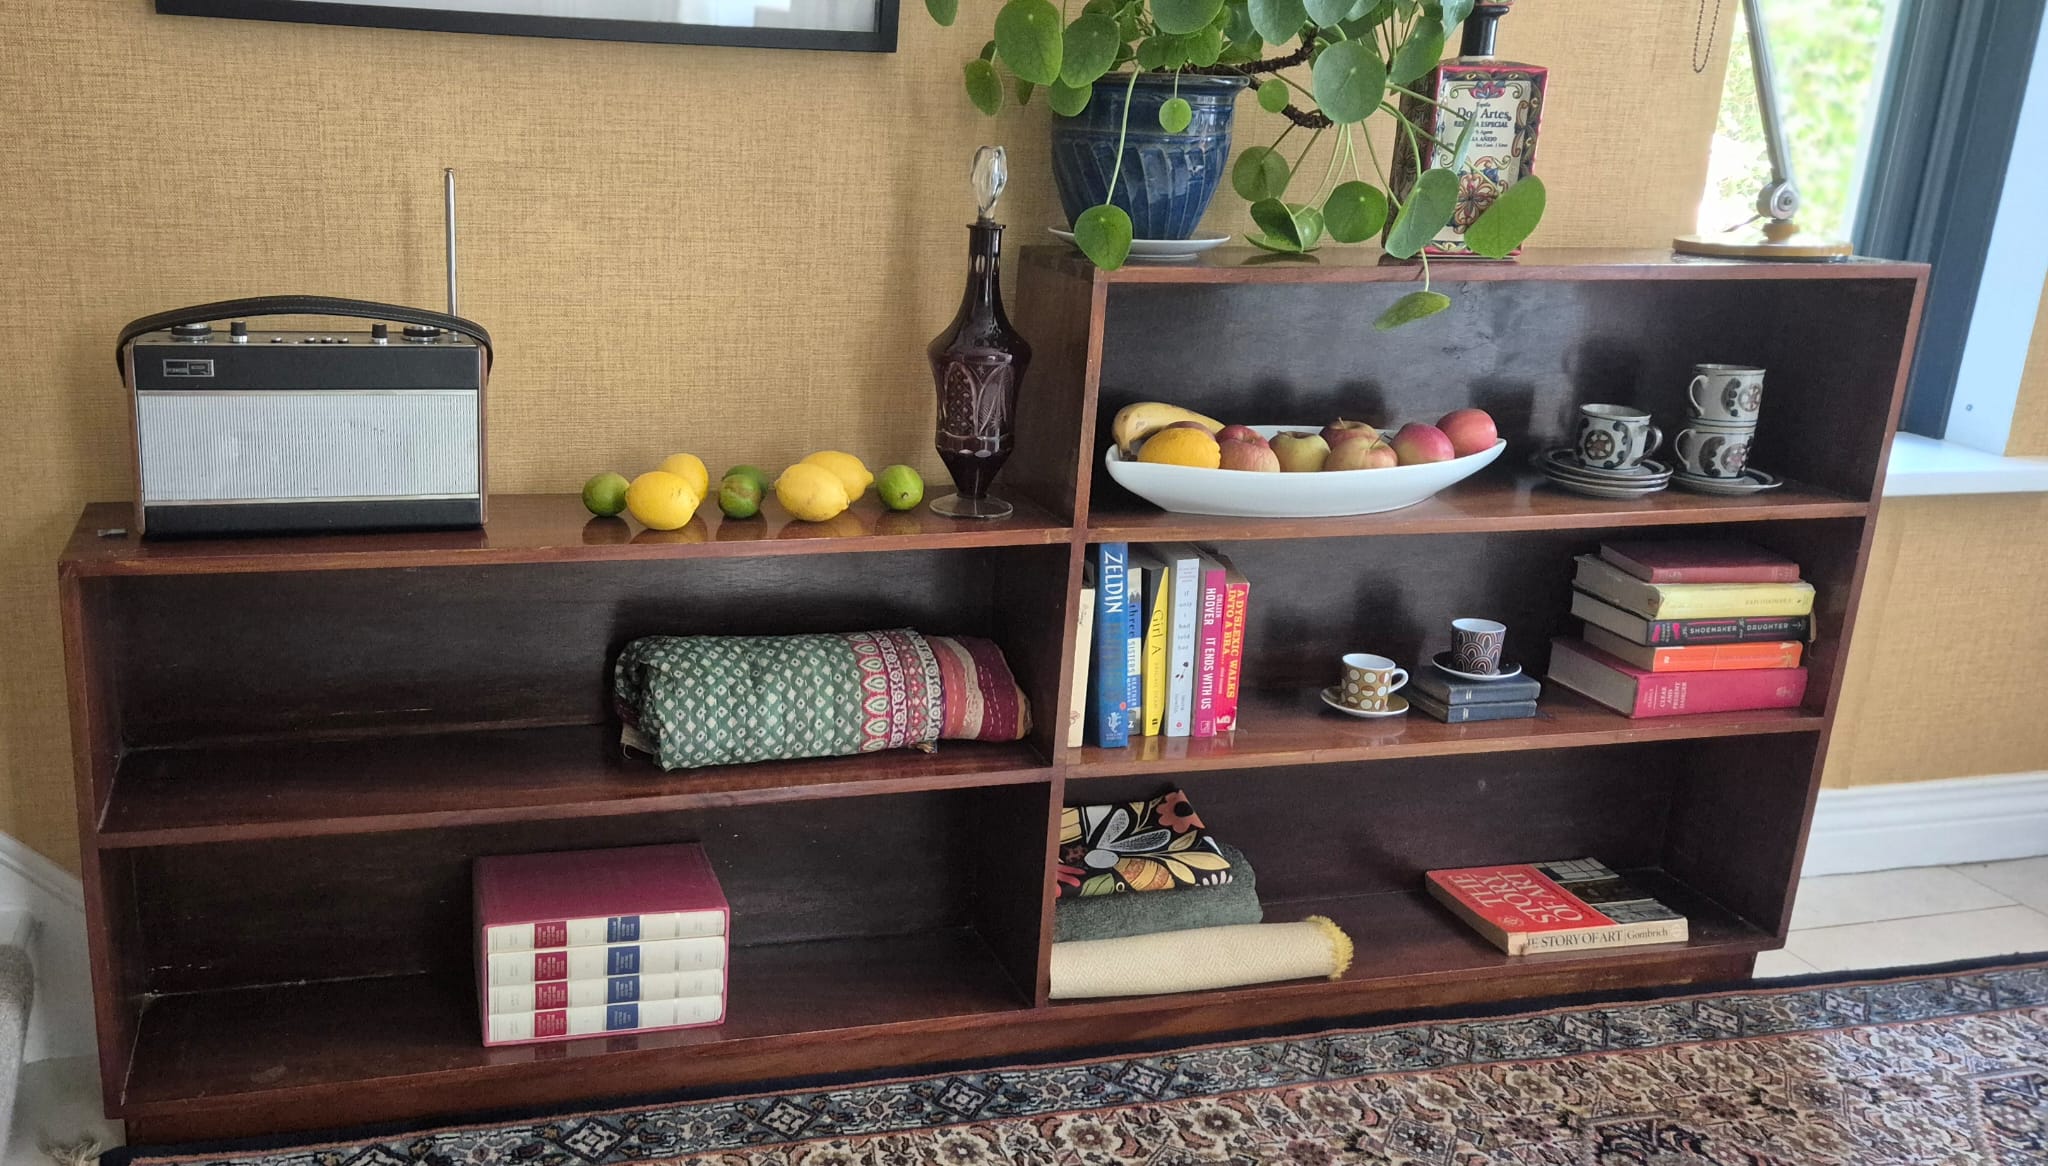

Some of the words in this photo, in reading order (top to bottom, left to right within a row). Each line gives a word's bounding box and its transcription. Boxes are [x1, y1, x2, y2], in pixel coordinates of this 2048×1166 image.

[1103, 550, 1124, 614] ZELDIN
[1204, 587, 1217, 626] HOOVER
[1215, 594, 1223, 618] COLLEEN
[1225, 590, 1237, 618] INTO
[1128, 603, 1139, 638] three
[1152, 609, 1164, 638] Girl
[1225, 621, 1233, 629] A
[1231, 600, 1245, 657] DYSLEXIC
[1689, 625, 1738, 634] SHOEMAKER
[1746, 622, 1789, 632] DAUGHTER
[1152, 645, 1162, 656] A
[1205, 637, 1217, 646] IT
[1204, 647, 1216, 671] ENDS
[1202, 672, 1214, 696] WITH
[1226, 659, 1239, 698] WALKS
[1200, 698, 1212, 710] US
[1448, 873, 1507, 908] THE
[1496, 870, 1555, 900] ART
[1473, 873, 1561, 924] STORY
[1538, 900, 1584, 922] OF
[1541, 932, 1579, 949] STORY
[1581, 931, 1601, 946] OF
[1599, 929, 1623, 944] ART
[1626, 926, 1669, 941] Gombrich
